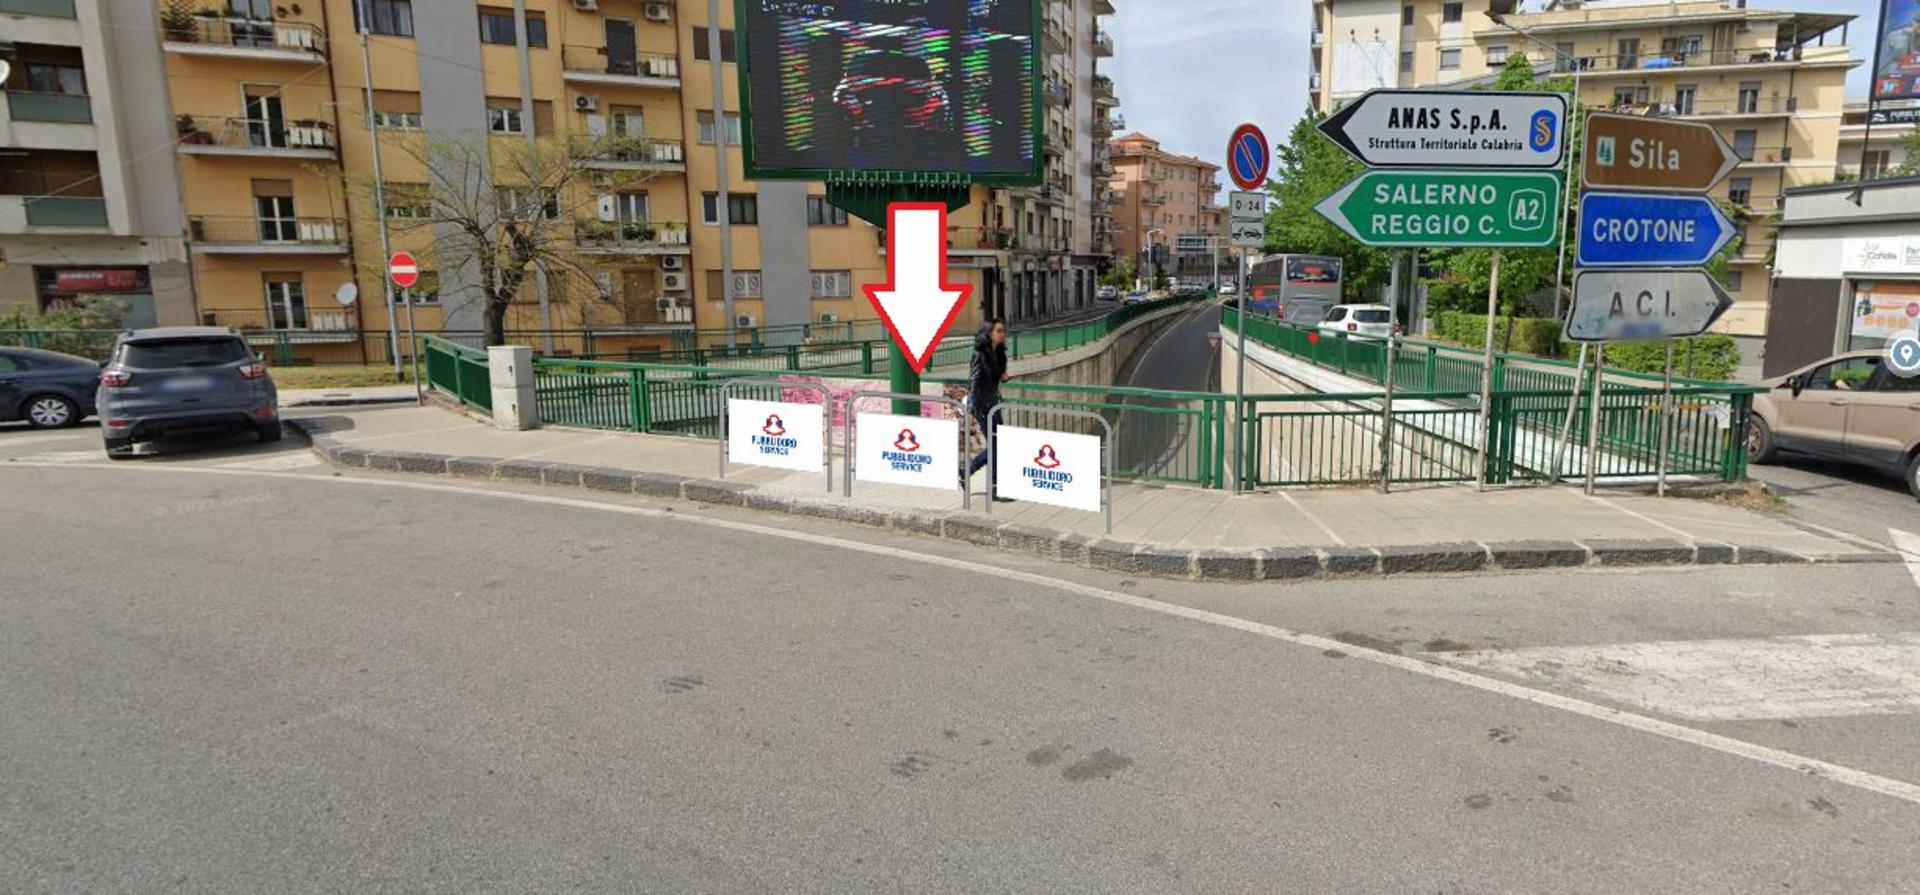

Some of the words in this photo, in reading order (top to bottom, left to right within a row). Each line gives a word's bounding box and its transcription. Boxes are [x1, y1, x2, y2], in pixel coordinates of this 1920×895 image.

[1388, 108, 1441, 130] ANAS
[1449, 109, 1508, 134] S.p.A.
[1368, 137, 1417, 151] Struttura
[1420, 137, 1478, 151] Territoriale
[1481, 137, 1524, 152] Calabria
[1629, 137, 1681, 170] Sila
[1374, 183, 1498, 206] SALERNO
[1514, 199, 1539, 221] A2
[1371, 213, 1471, 236] REGGIO
[1478, 215, 1502, 236] C.
[1592, 217, 1697, 244] CROTONE
[759, 446, 790, 456] SERVICE
[890, 462, 923, 473] SERVICE
[1031, 479, 1064, 492] SERVICE
